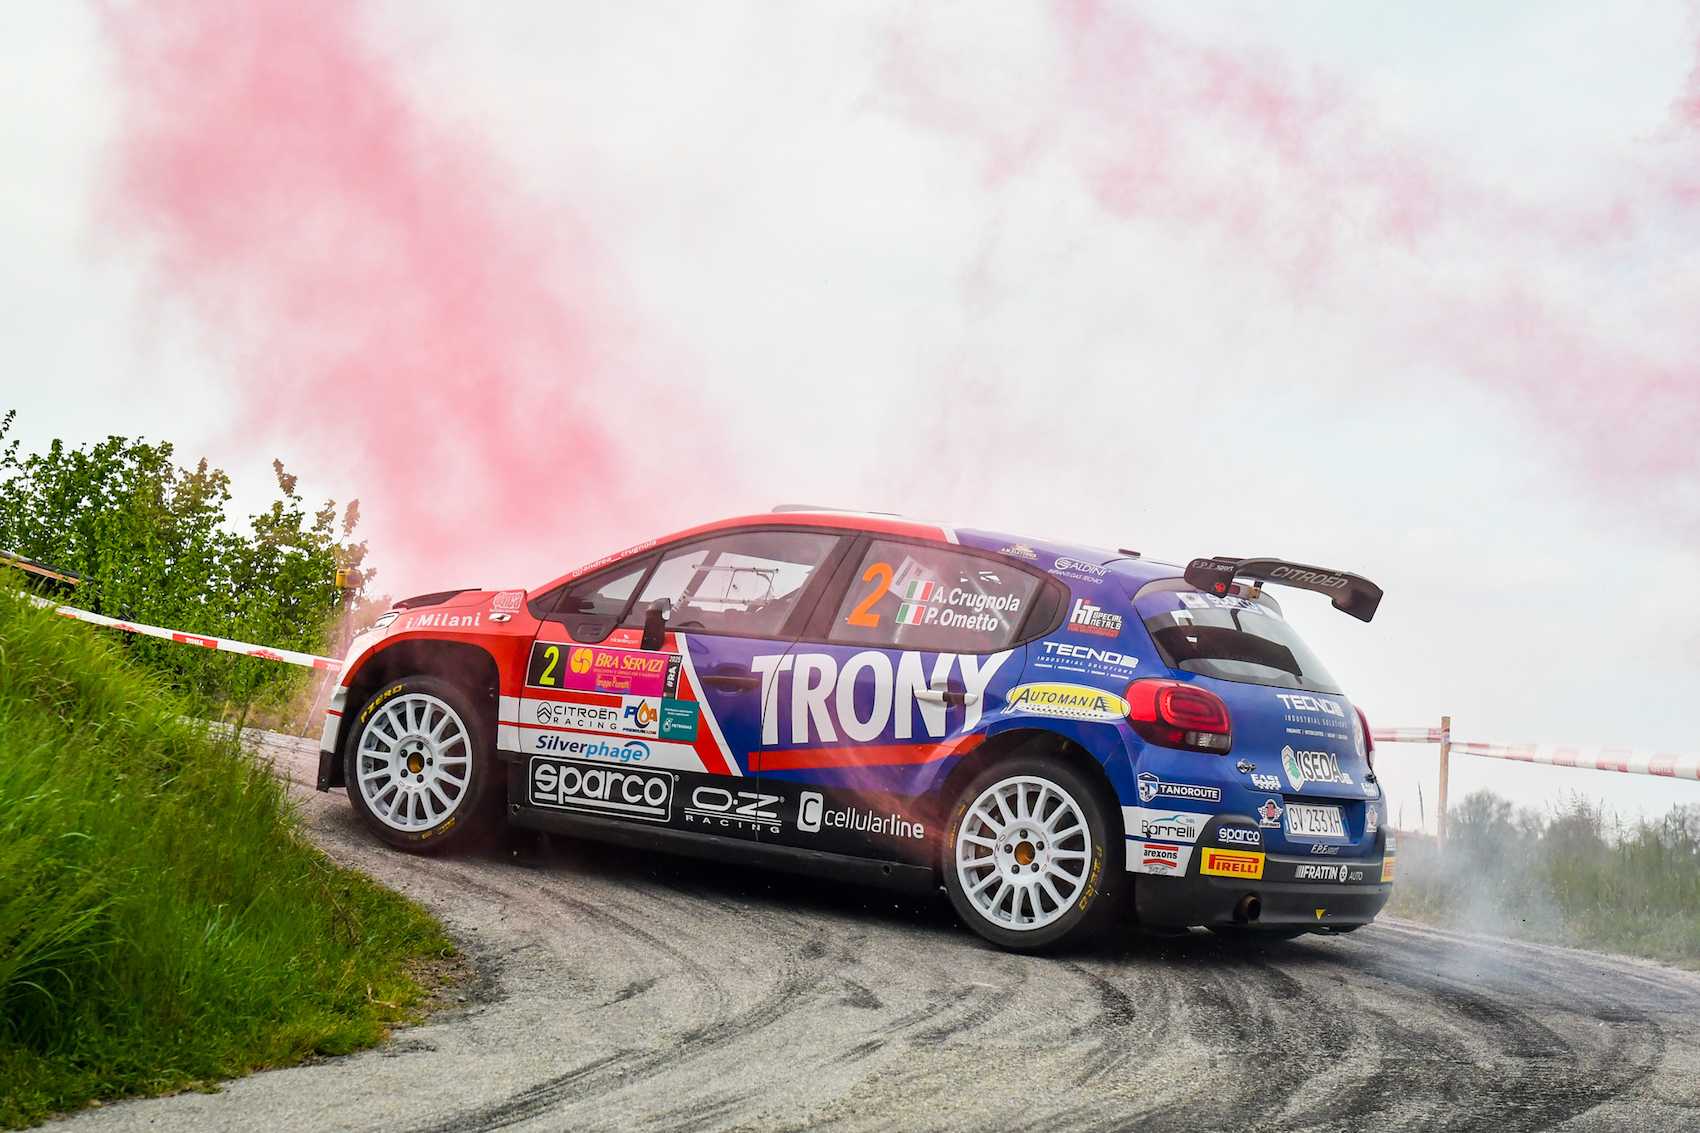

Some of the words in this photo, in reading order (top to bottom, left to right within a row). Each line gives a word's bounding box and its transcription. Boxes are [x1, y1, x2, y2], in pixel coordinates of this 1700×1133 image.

[848, 562, 893, 628] 2
[539, 646, 559, 686] 2
[751, 650, 1014, 745] TRONY
[554, 717, 617, 729] RACING
[536, 735, 643, 762] Silverphage
[535, 763, 668, 806] sparco
[686, 815, 781, 834] RACING
[824, 807, 925, 839] cellularline
[1219, 827, 1261, 844] sparco
[1143, 849, 1178, 860] arexons
[1208, 853, 1260, 873] PIRELLI
